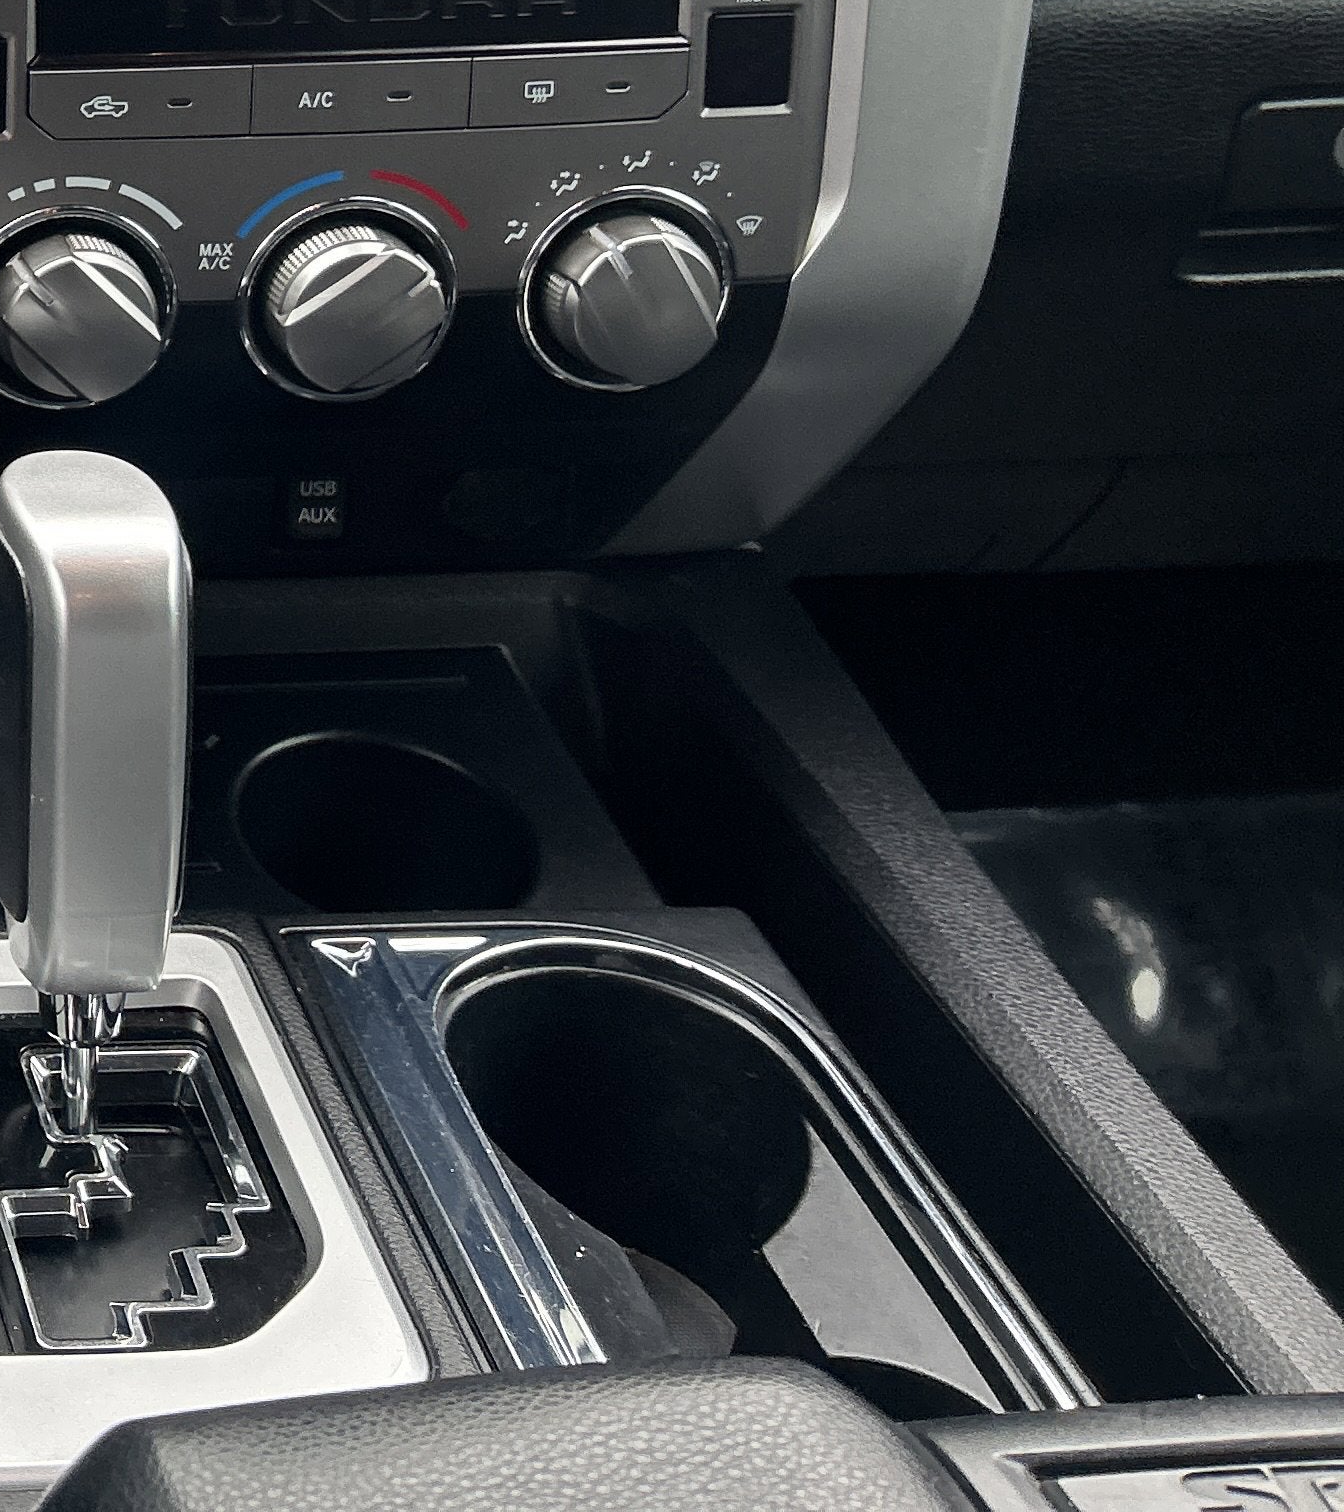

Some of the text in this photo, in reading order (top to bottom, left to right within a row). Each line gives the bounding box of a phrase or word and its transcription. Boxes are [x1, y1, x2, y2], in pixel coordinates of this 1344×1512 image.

[298, 91, 334, 110] A/C
[199, 242, 234, 258] MAX
[198, 256, 232, 272] A/C
[299, 479, 338, 497] USB
[298, 506, 338, 525] AUX
